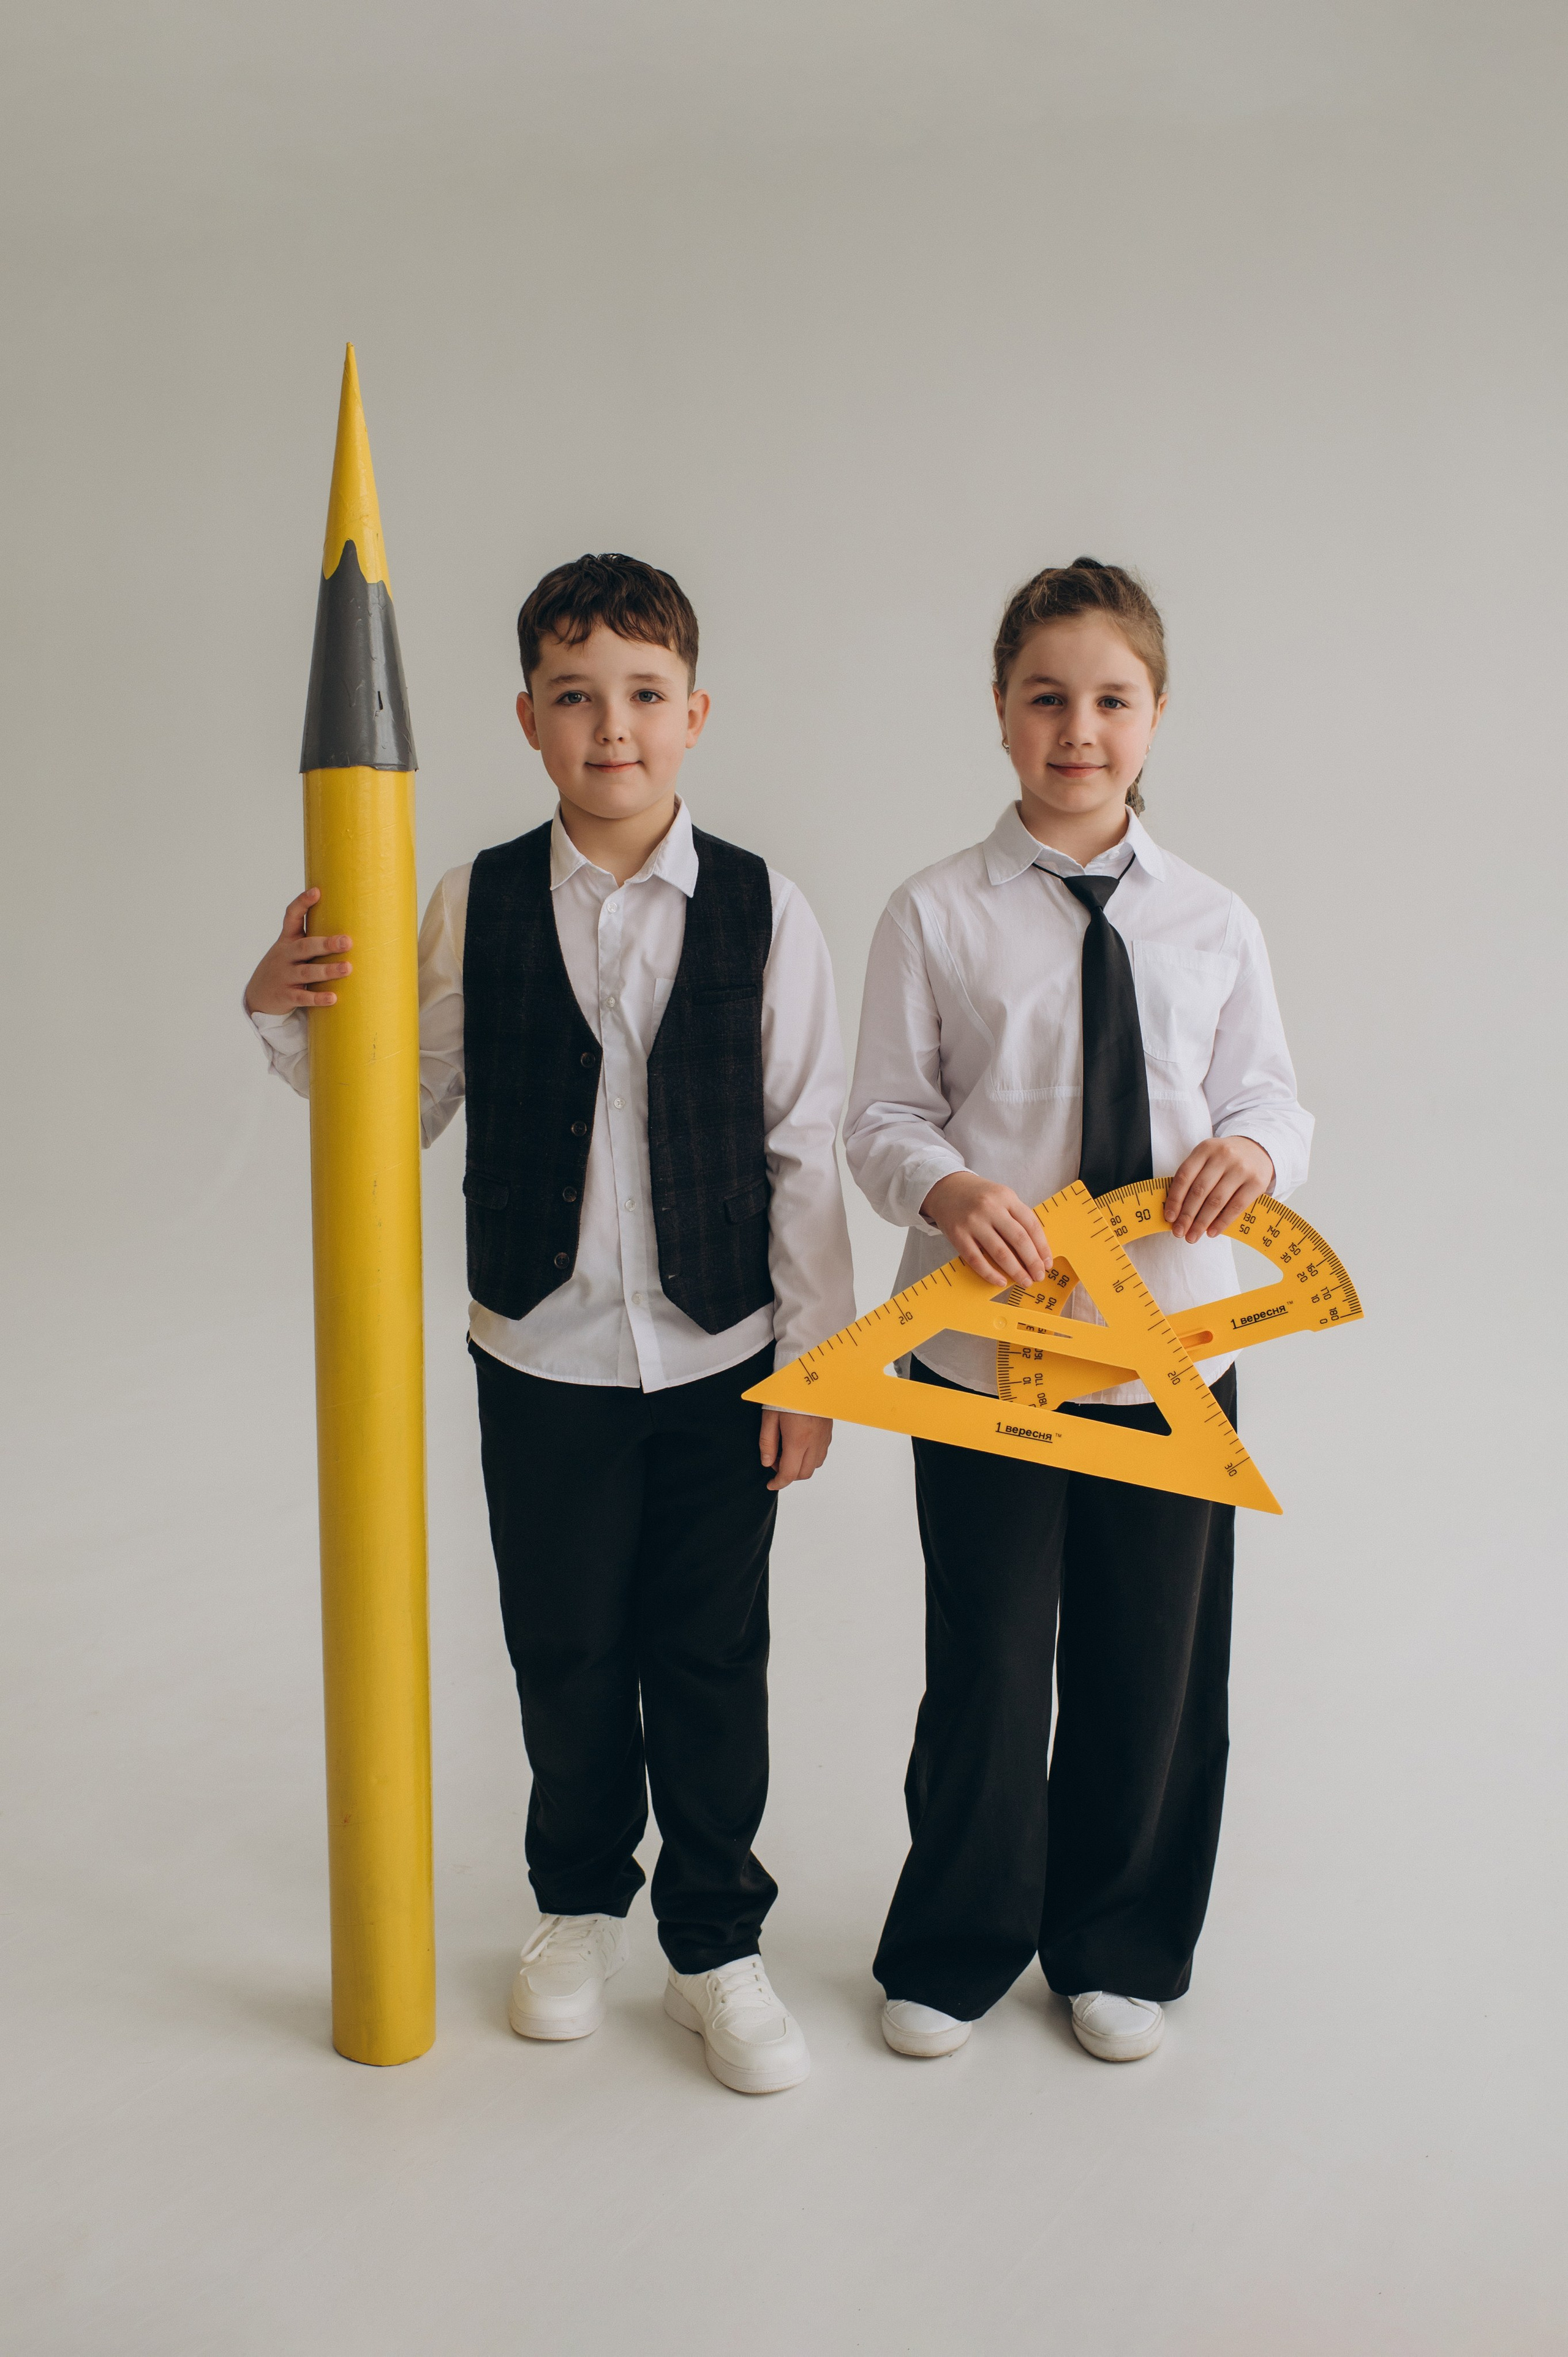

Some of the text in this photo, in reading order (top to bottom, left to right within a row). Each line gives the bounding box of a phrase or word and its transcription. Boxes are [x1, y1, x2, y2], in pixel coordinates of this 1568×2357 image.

[1110, 1215, 1121, 1226] 80
[1136, 1209, 1151, 1223] 90
[1243, 1212, 1256, 1224] 130
[1114, 1226, 1128, 1237] 100
[1239, 1224, 1250, 1234] 50
[1267, 1225, 1280, 1238] 140
[1262, 1235, 1272, 1247] 40
[1288, 1242, 1301, 1256] 150
[1280, 1252, 1292, 1263] 30
[1048, 1269, 1059, 1281] 50
[1306, 1262, 1319, 1277] 160
[1057, 1275, 1070, 1288] 130
[1297, 1271, 1308, 1283] 20
[1035, 1293, 1046, 1305] 40
[1311, 1294, 1320, 1303] 10
[1321, 1286, 1332, 1301] 170
[1045, 1297, 1057, 1311] 140
[898, 1311, 913, 1325] 20
[1231, 1319, 1238, 1329] 1
[1240, 1305, 1286, 1322] вересня
[1329, 1307, 1340, 1321] 180
[1022, 1348, 1031, 1359] 20
[804, 1371, 819, 1385] 30
[1023, 1376, 1031, 1386] 10
[1035, 1373, 1043, 1386] 170
[1167, 1371, 1180, 1386] 20
[1037, 1392, 1047, 1407] 180
[995, 1422, 1001, 1432] 1
[1005, 1425, 1052, 1441] вересня
[1224, 1462, 1237, 1477] 30
